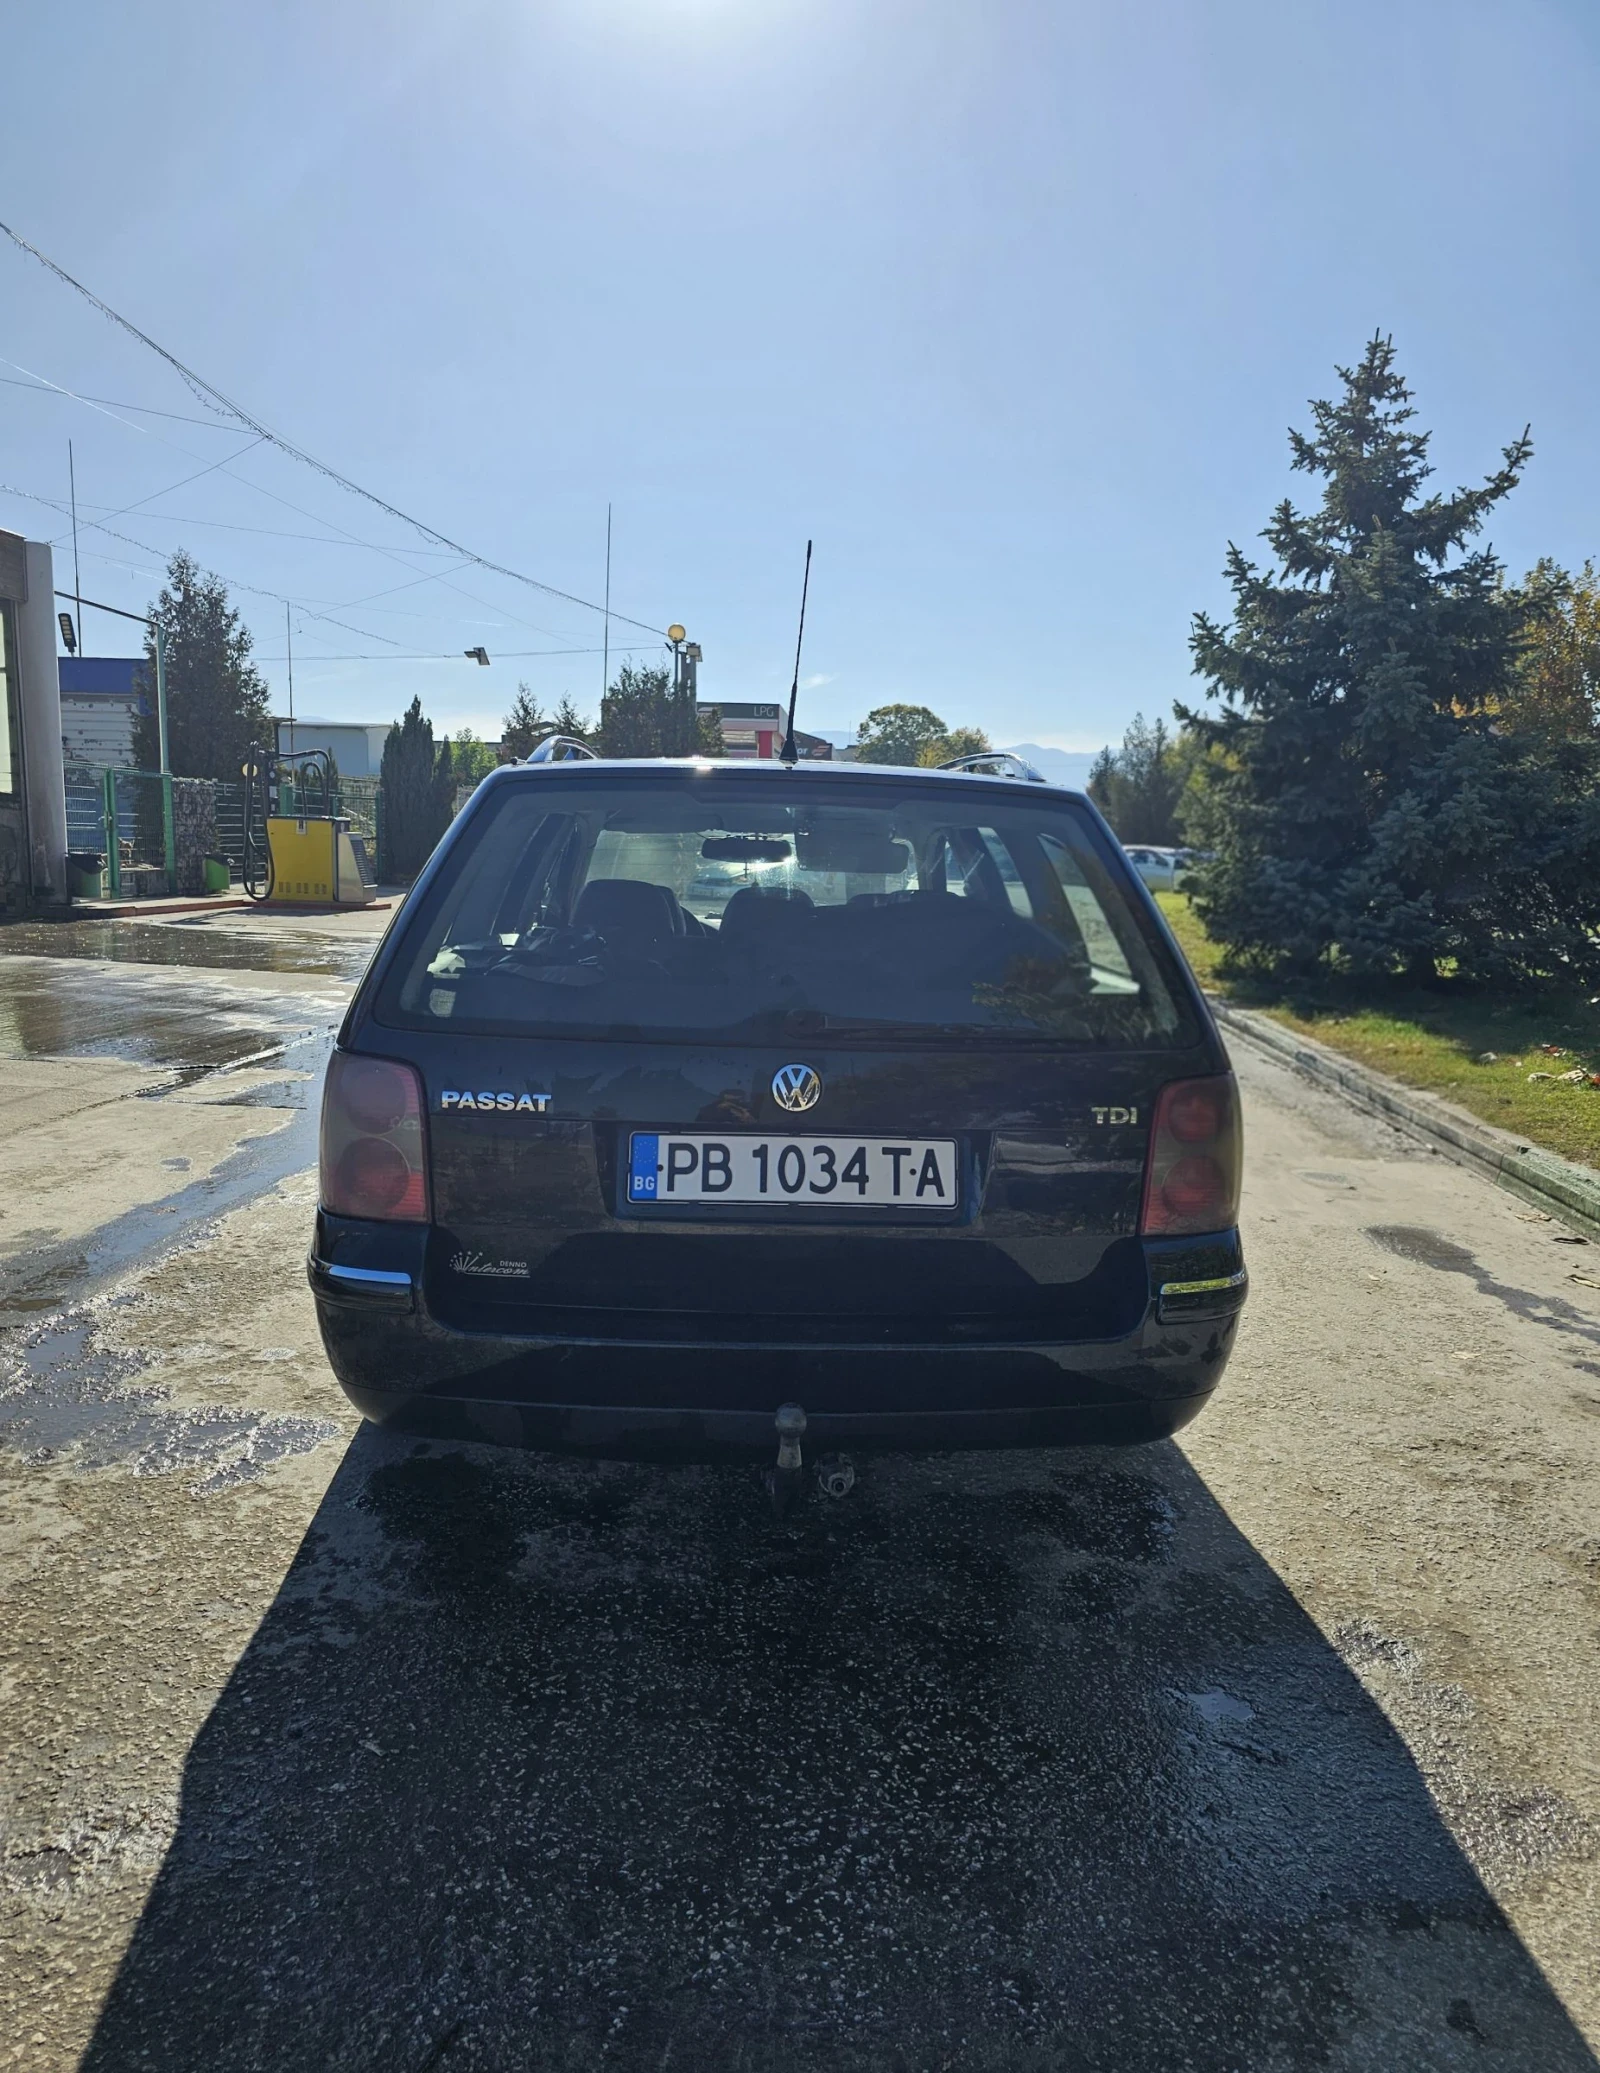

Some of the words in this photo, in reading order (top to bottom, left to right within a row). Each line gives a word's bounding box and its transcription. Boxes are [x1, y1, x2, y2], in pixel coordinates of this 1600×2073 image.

[753, 705, 774, 717] LPG
[441, 1090, 551, 1112] PASSAT
[1091, 1107, 1138, 1124] TDI
[666, 1142, 733, 1193] PB
[752, 1143, 869, 1195] 1034
[881, 1146, 946, 1198] TA
[633, 1175, 655, 1191] BG
[500, 1260, 527, 1268] DENNO
